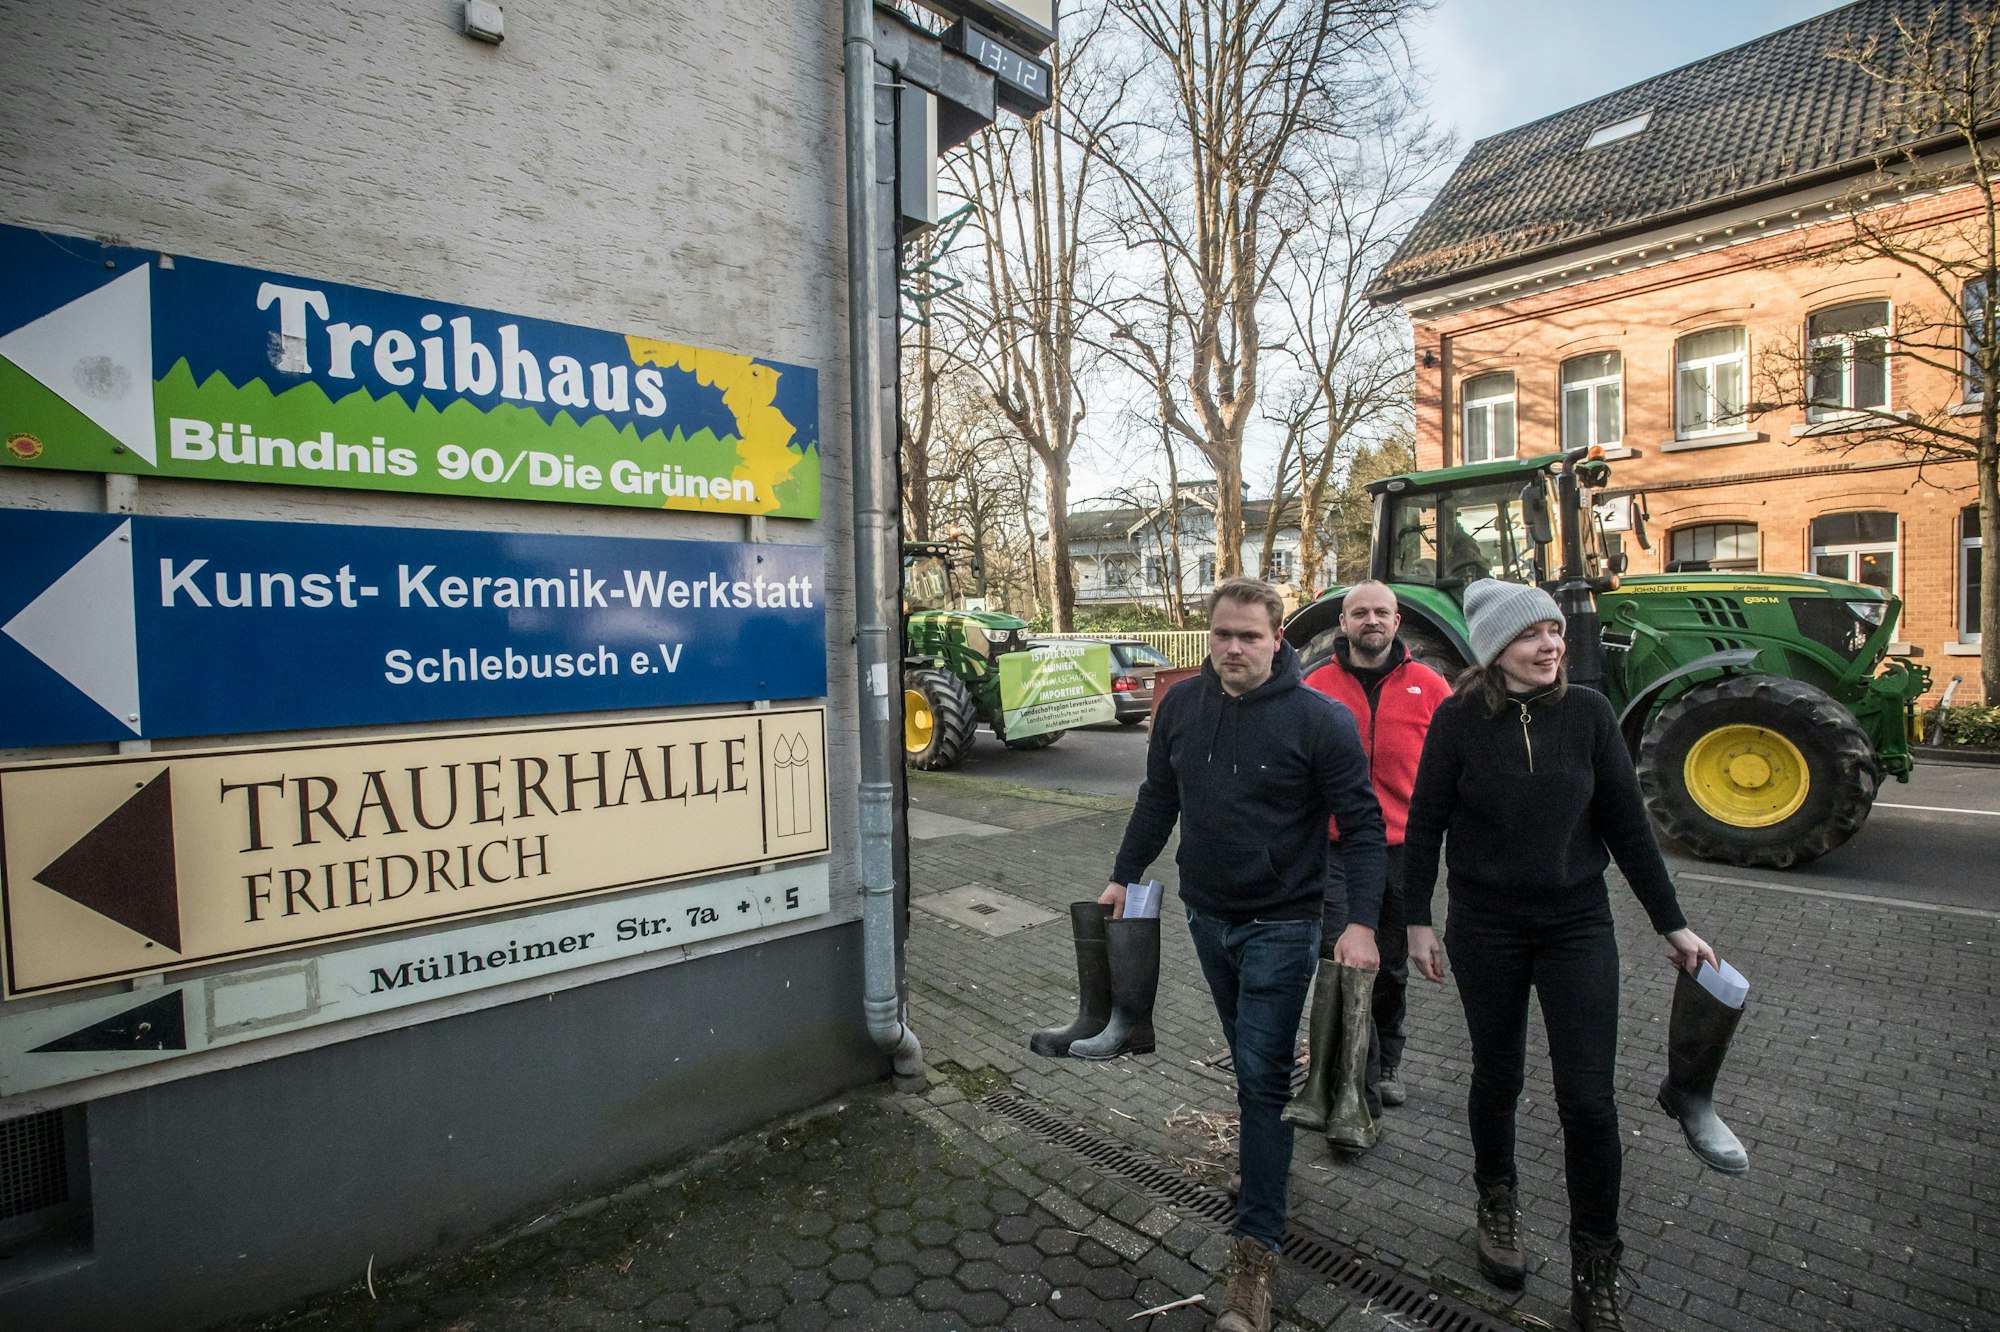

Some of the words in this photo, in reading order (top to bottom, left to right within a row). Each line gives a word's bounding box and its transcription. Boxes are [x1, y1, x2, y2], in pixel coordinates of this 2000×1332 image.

[979, 41, 1038, 91] 13:12
[256, 281, 667, 418] Treibhaus
[169, 417, 418, 476] Bündnis
[436, 444, 602, 490] 90/Die
[609, 460, 755, 502] Grünen
[160, 558, 379, 608] Kunst-
[399, 563, 813, 609] Keramik-Werkstatt
[1632, 586, 1656, 594] JOHN
[385, 644, 618, 686] Schlebusch
[630, 643, 684, 676] e.V
[1031, 652, 1043, 662] IST
[1045, 649, 1060, 660] DER
[1020, 702, 1069, 717] Landschaftsplan
[1070, 698, 1103, 708] Leverkusen:
[1040, 685, 1085, 701] IMPORTIERT
[220, 734, 749, 854] TRAUERHALLE
[242, 835, 552, 924] FRIEDRICH
[369, 930, 595, 994] Mülheimer
[616, 914, 672, 942] Str.
[686, 906, 719, 927] 7a
